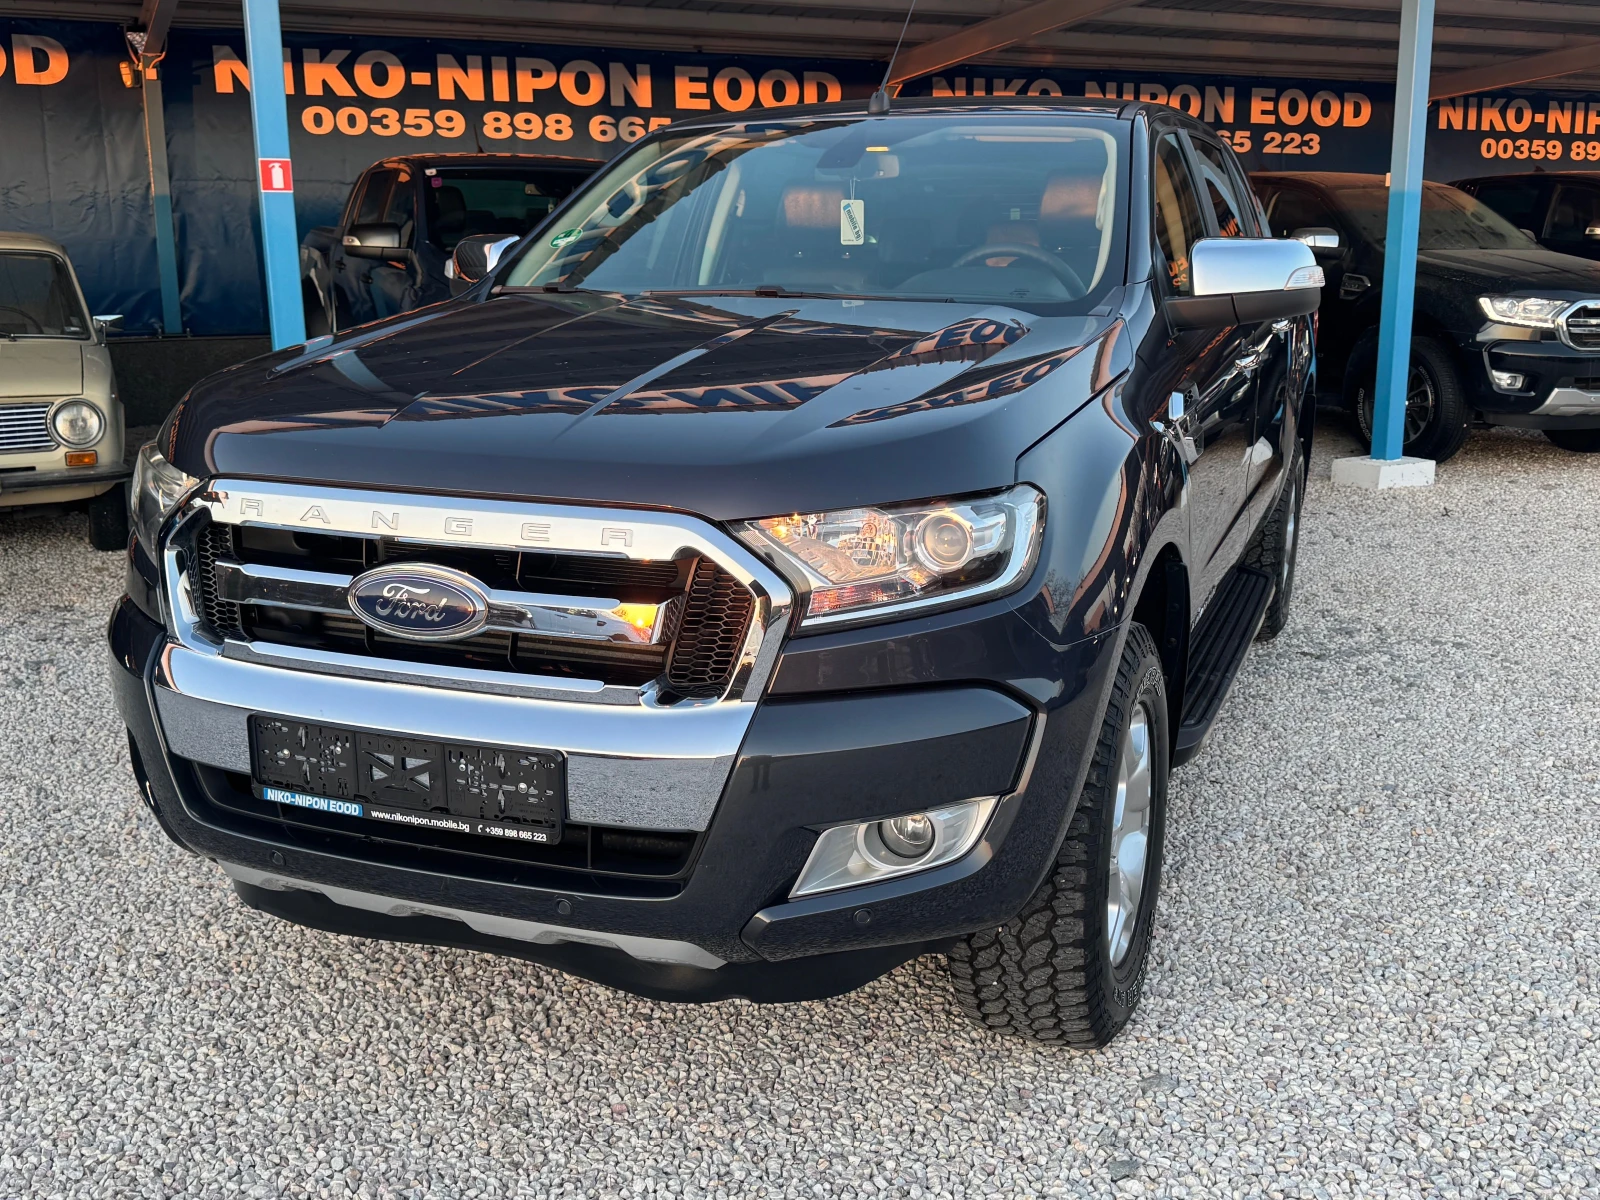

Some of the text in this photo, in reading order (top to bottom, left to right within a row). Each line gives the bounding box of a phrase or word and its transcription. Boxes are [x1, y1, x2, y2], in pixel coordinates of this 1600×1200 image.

[213, 47, 843, 112] NIKO-NIPON EOOD
[301, 105, 466, 138] 00359
[482, 110, 574, 141] 898
[1250, 87, 1372, 128] EOOD
[1262, 131, 1321, 155] 223
[1481, 138, 1563, 161] 00359
[240, 498, 632, 548] RANGER
[375, 583, 449, 623] Ford
[267, 788, 359, 815] NIKO-NIPON EOOD
[371, 810, 547, 842] www.nikonipon.mobile.bg +359 898 665 223
